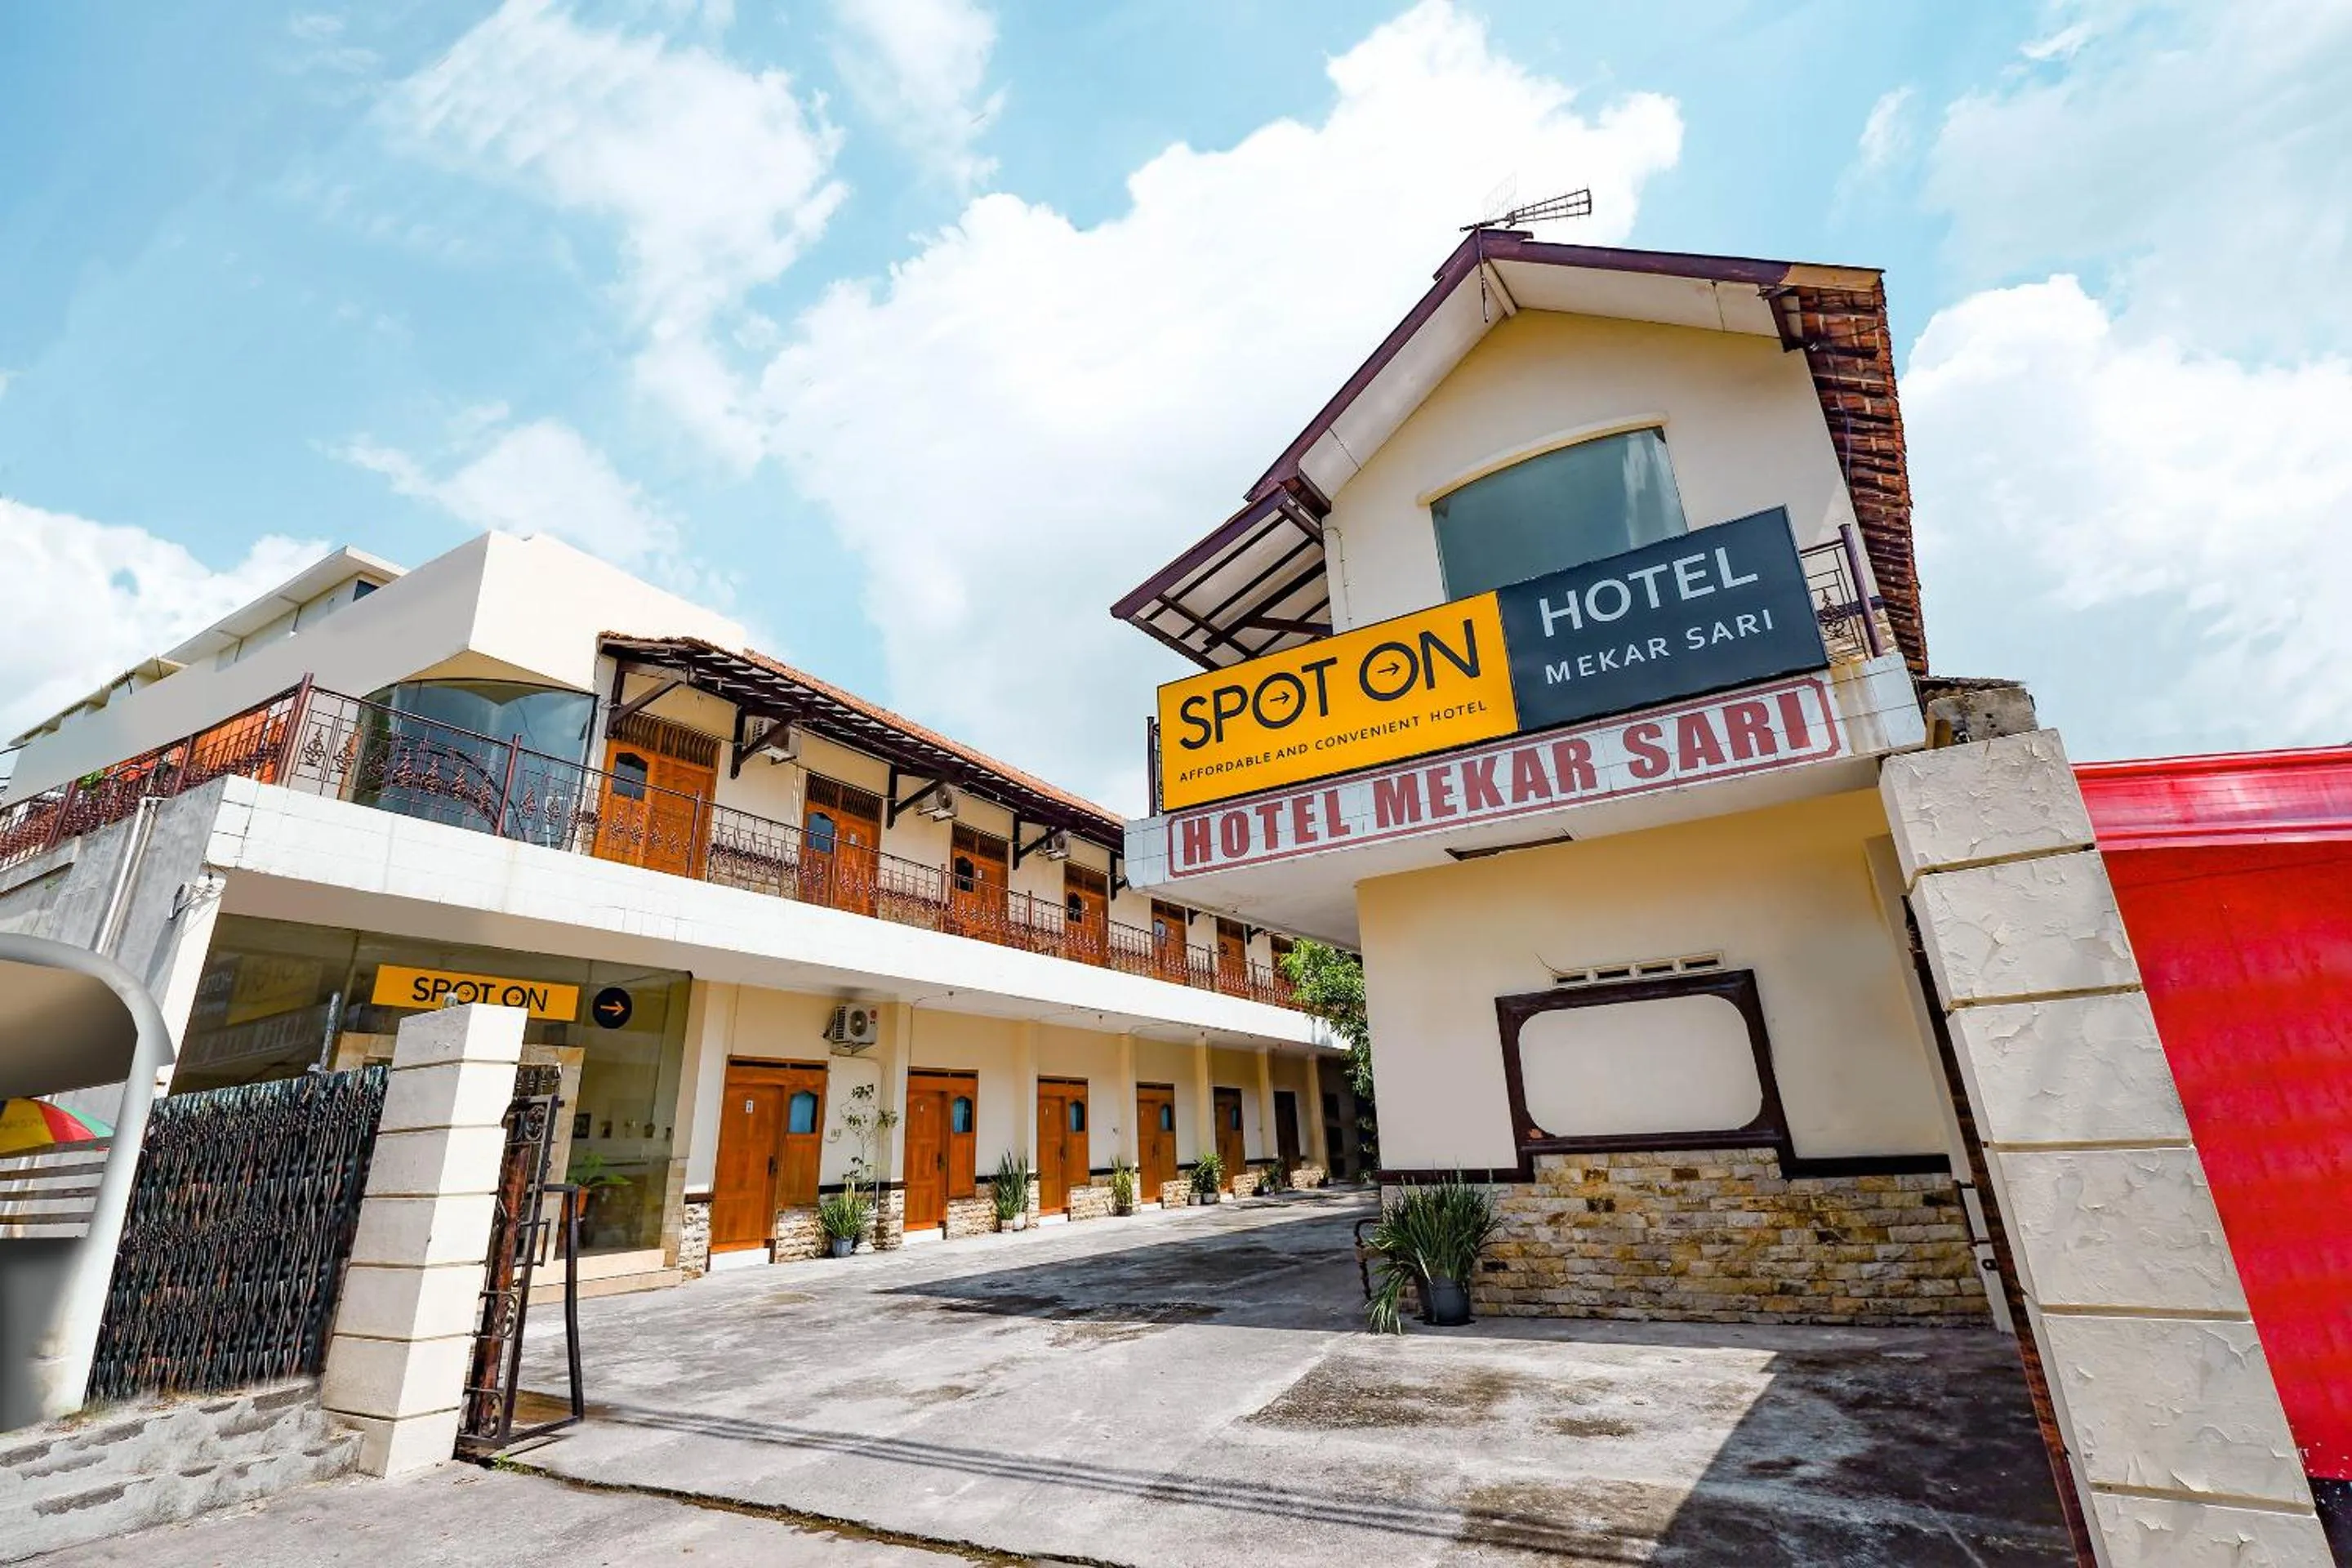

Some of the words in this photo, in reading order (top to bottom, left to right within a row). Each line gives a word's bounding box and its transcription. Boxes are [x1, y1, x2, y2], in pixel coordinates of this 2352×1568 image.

[1539, 546, 1758, 637] HOTEL
[1179, 657, 1338, 751] SPOT
[1359, 619, 1481, 702] ON
[1545, 637, 1671, 684] MEKAR
[1685, 609, 1773, 650] SARI
[1179, 752, 1271, 782] AFFORDABLE
[1276, 744, 1308, 760] AND
[1315, 715, 1420, 751] CONVENIENT
[1430, 700, 1487, 723] HOTEL
[1182, 791, 1351, 866] HOTEL
[1373, 738, 1598, 828] MEKAR
[1622, 692, 1813, 779] SARI
[412, 977, 496, 1005] SPOT
[501, 986, 548, 1013] ON
